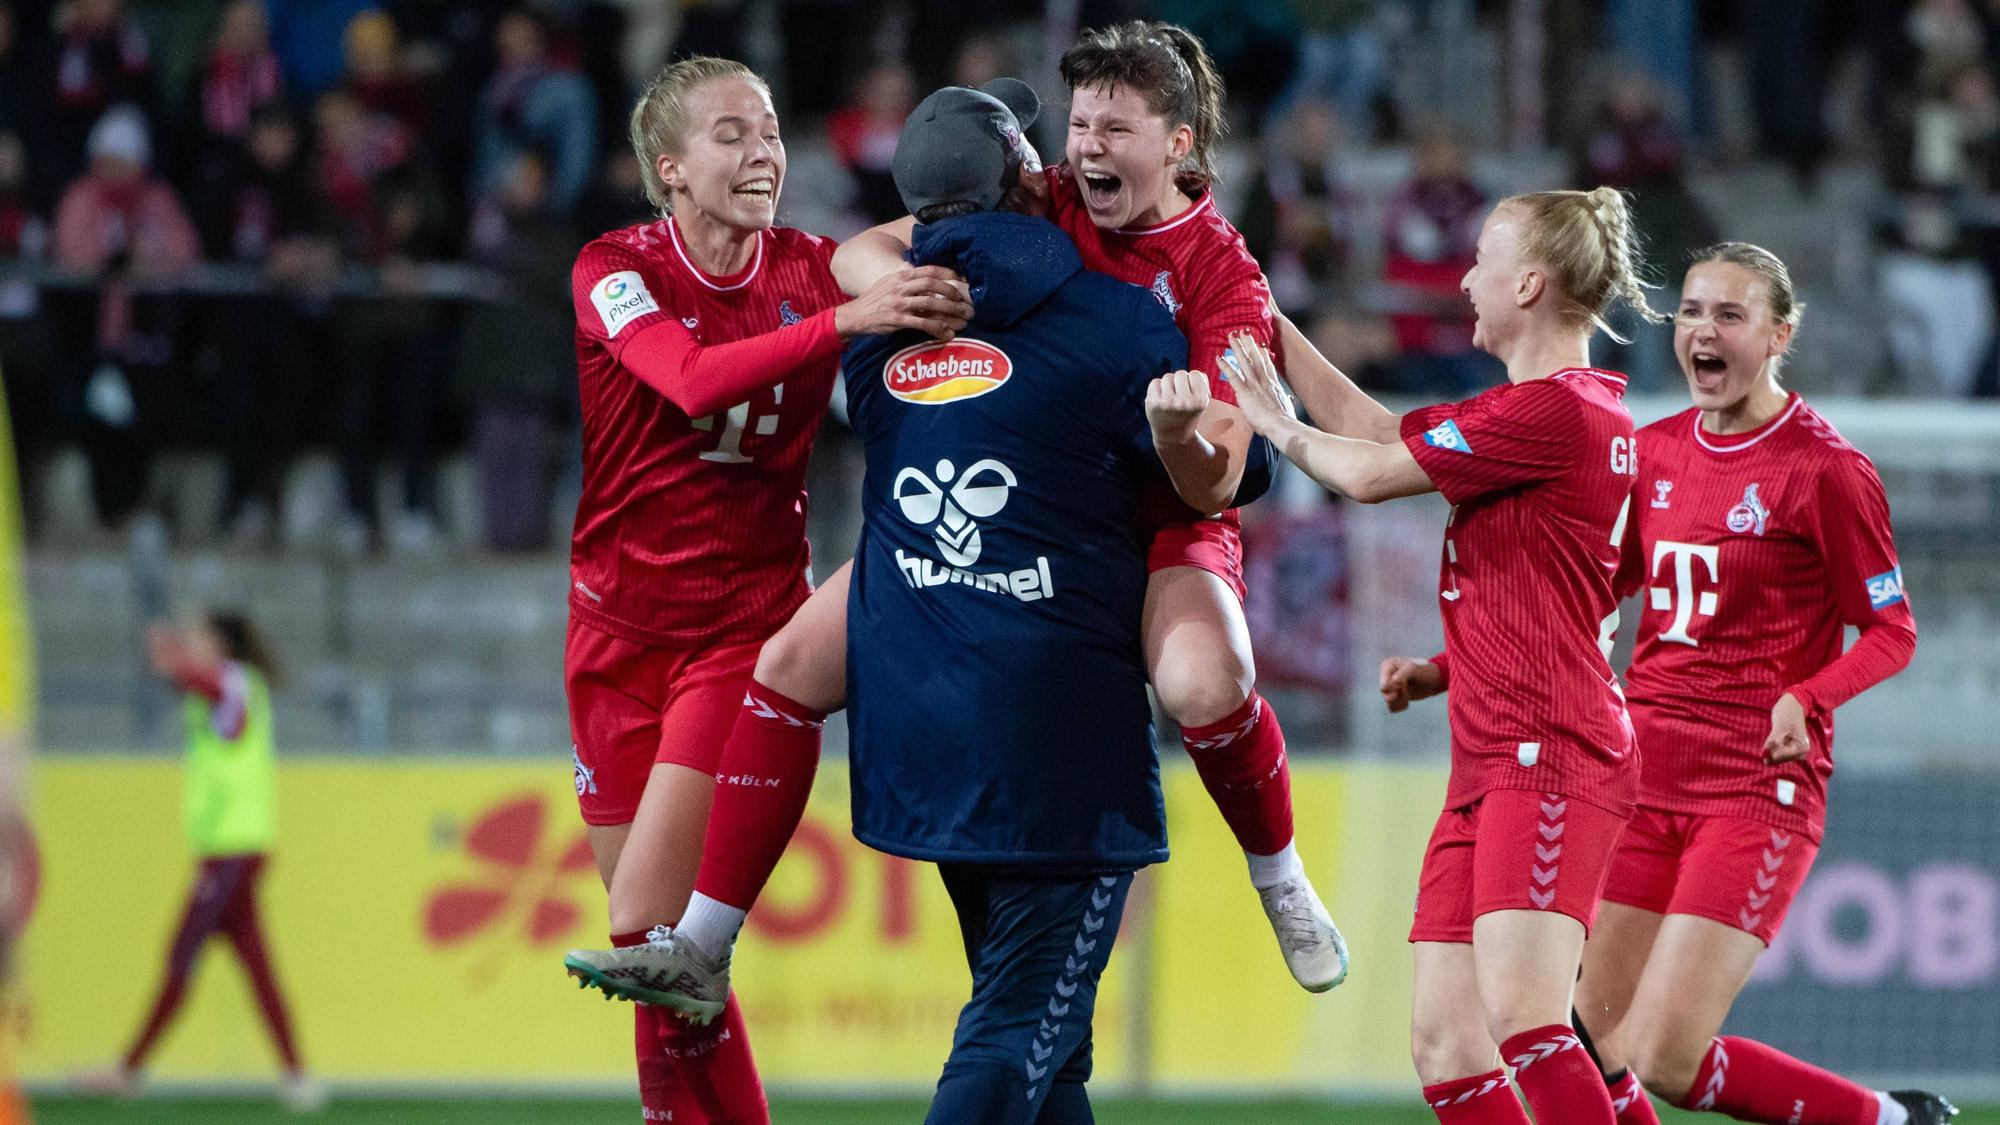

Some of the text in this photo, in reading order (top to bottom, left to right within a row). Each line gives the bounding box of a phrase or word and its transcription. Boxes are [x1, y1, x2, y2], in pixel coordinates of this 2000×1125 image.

[604, 278, 627, 300] G
[896, 355, 993, 384] Schaebens
[895, 549, 1054, 602] hummel
[1650, 540, 1719, 647] T
[727, 774, 780, 788] KÖLN
[642, 1107, 672, 1121] ÖLN
